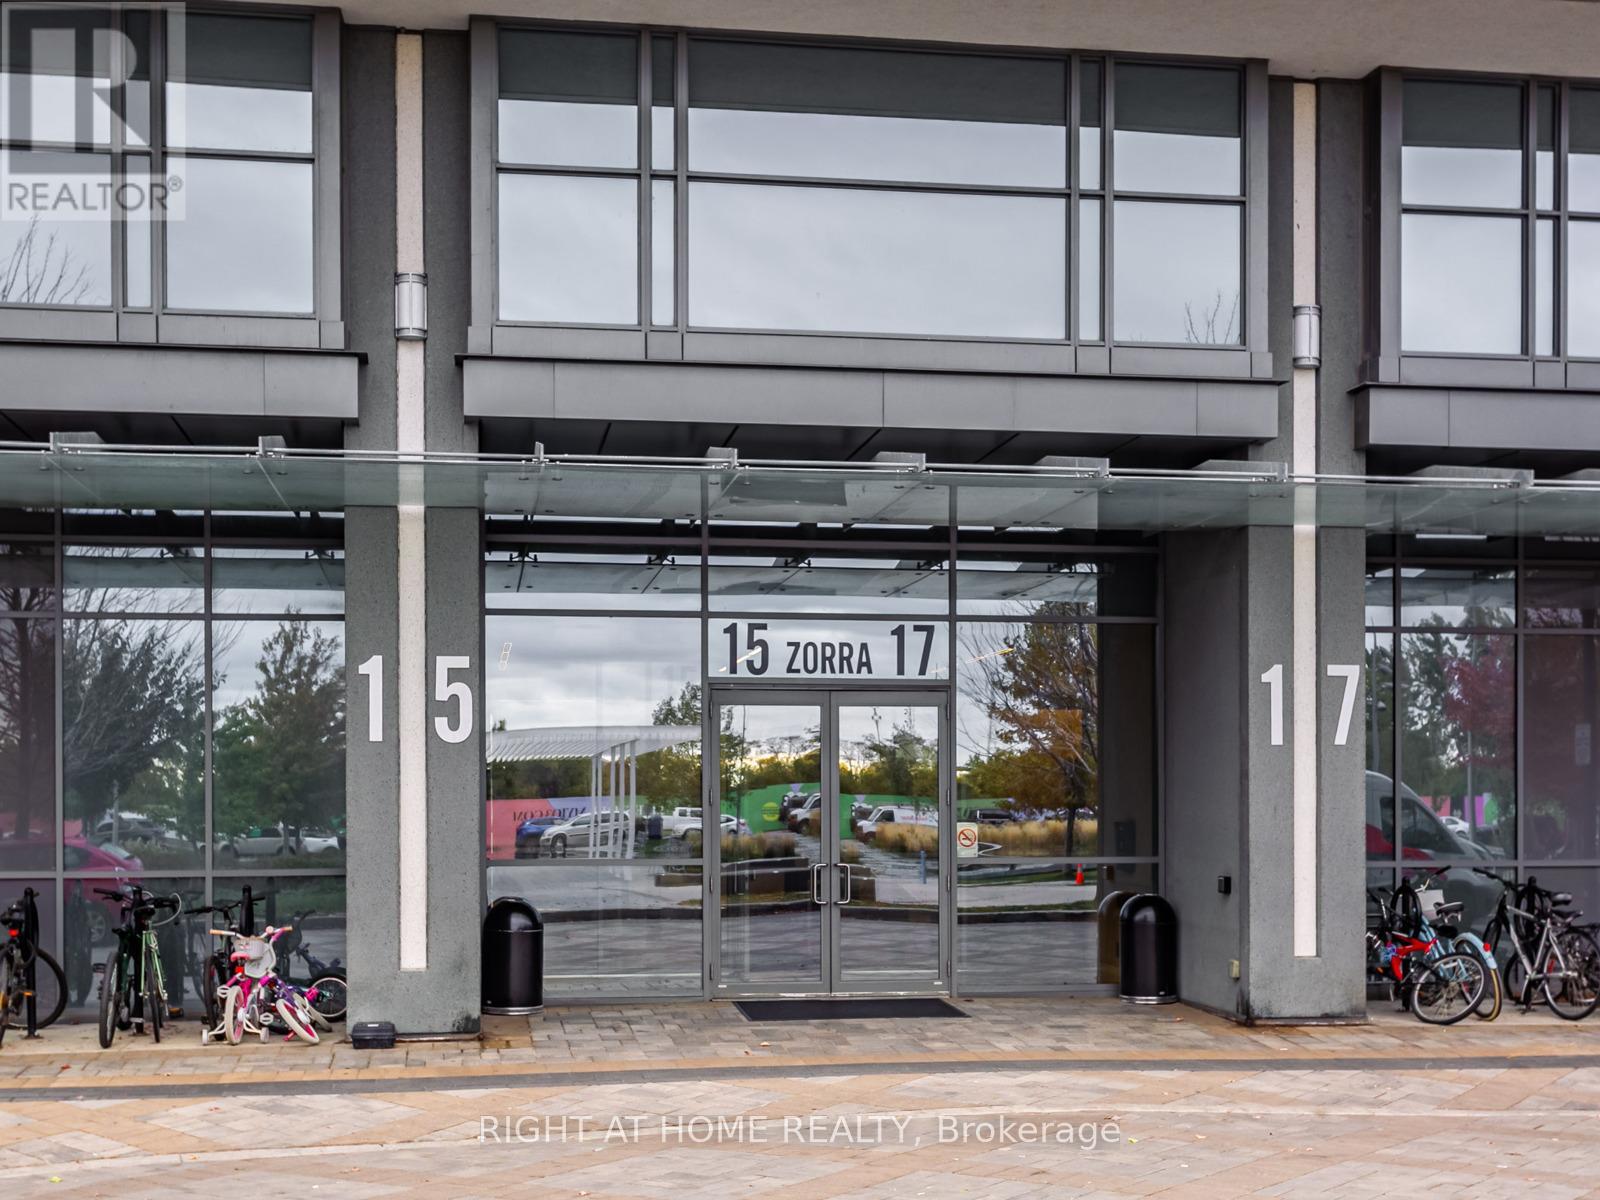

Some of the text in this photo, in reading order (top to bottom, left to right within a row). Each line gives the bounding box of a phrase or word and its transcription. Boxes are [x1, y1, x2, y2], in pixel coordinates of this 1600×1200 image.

[722, 622, 935, 676] 15 ZORRA 17
